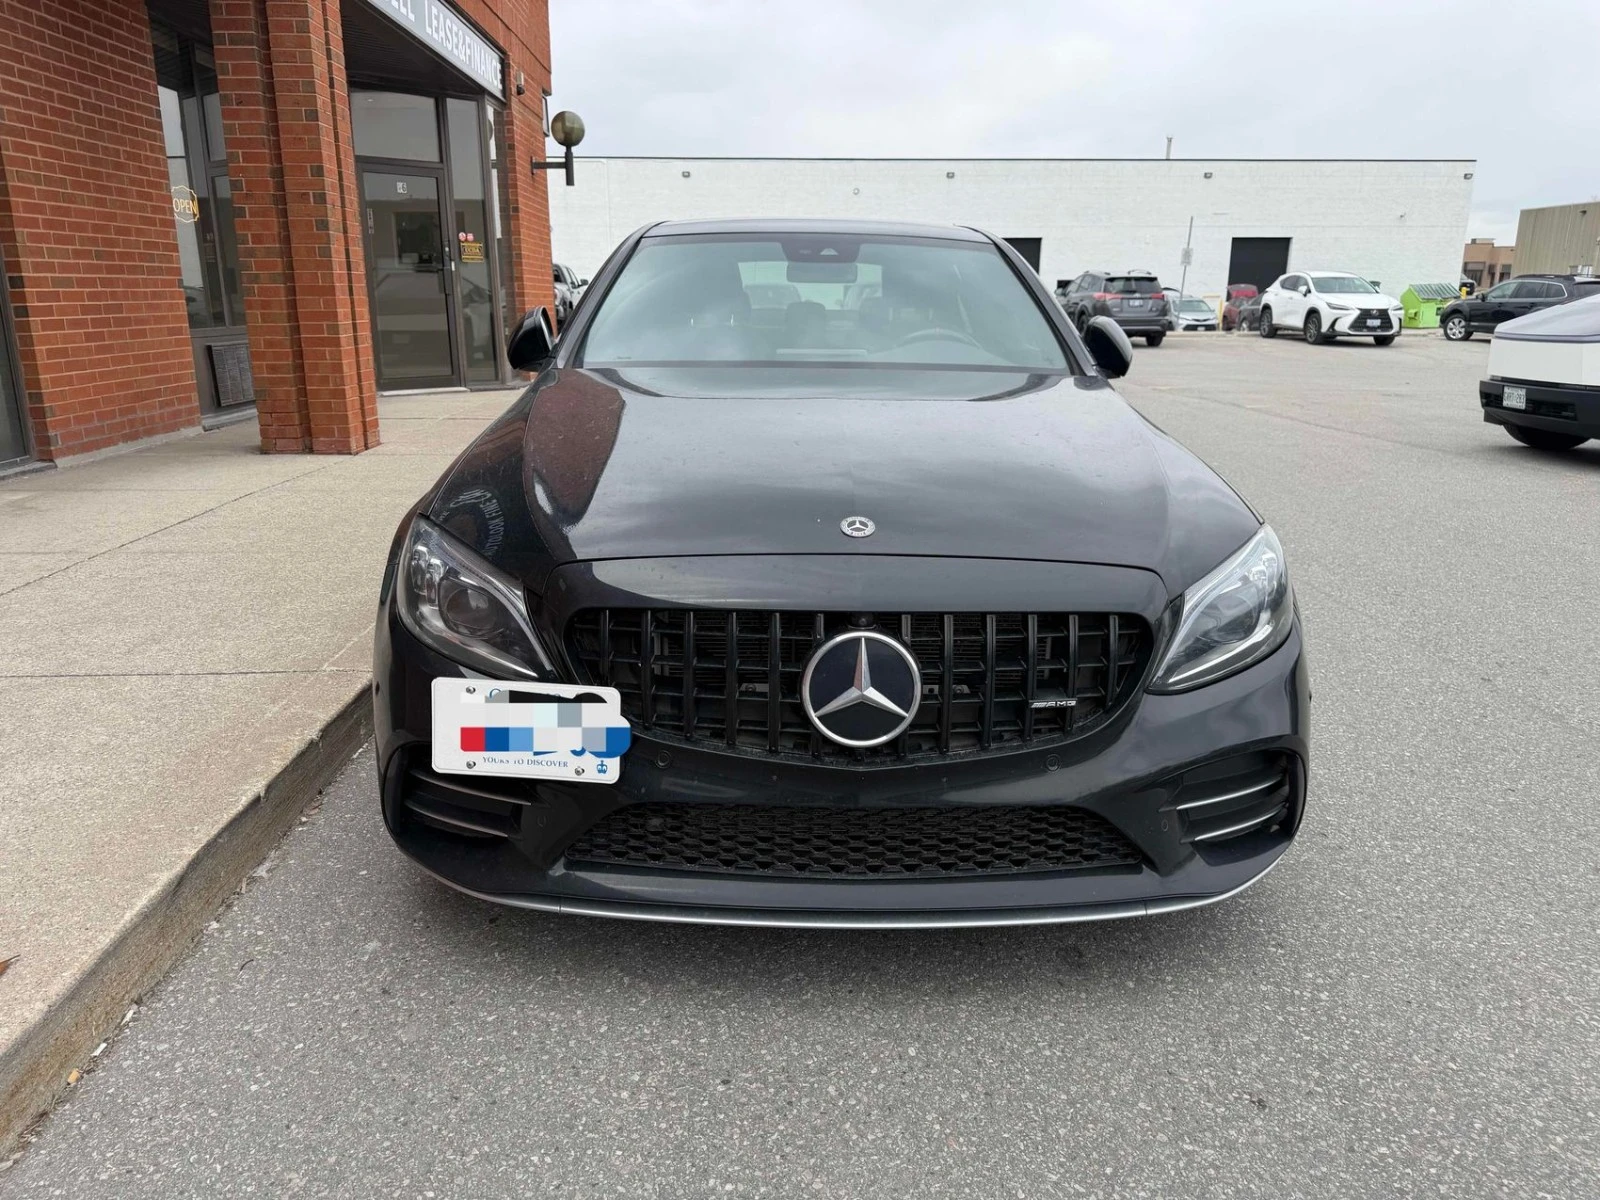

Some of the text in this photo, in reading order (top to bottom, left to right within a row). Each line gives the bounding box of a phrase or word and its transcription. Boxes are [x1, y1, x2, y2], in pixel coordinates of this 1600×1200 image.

[424, 0, 502, 90] LEASE&FINANCE
[172, 198, 197, 214] OPEN
[527, 758, 569, 768] DISCOVER
